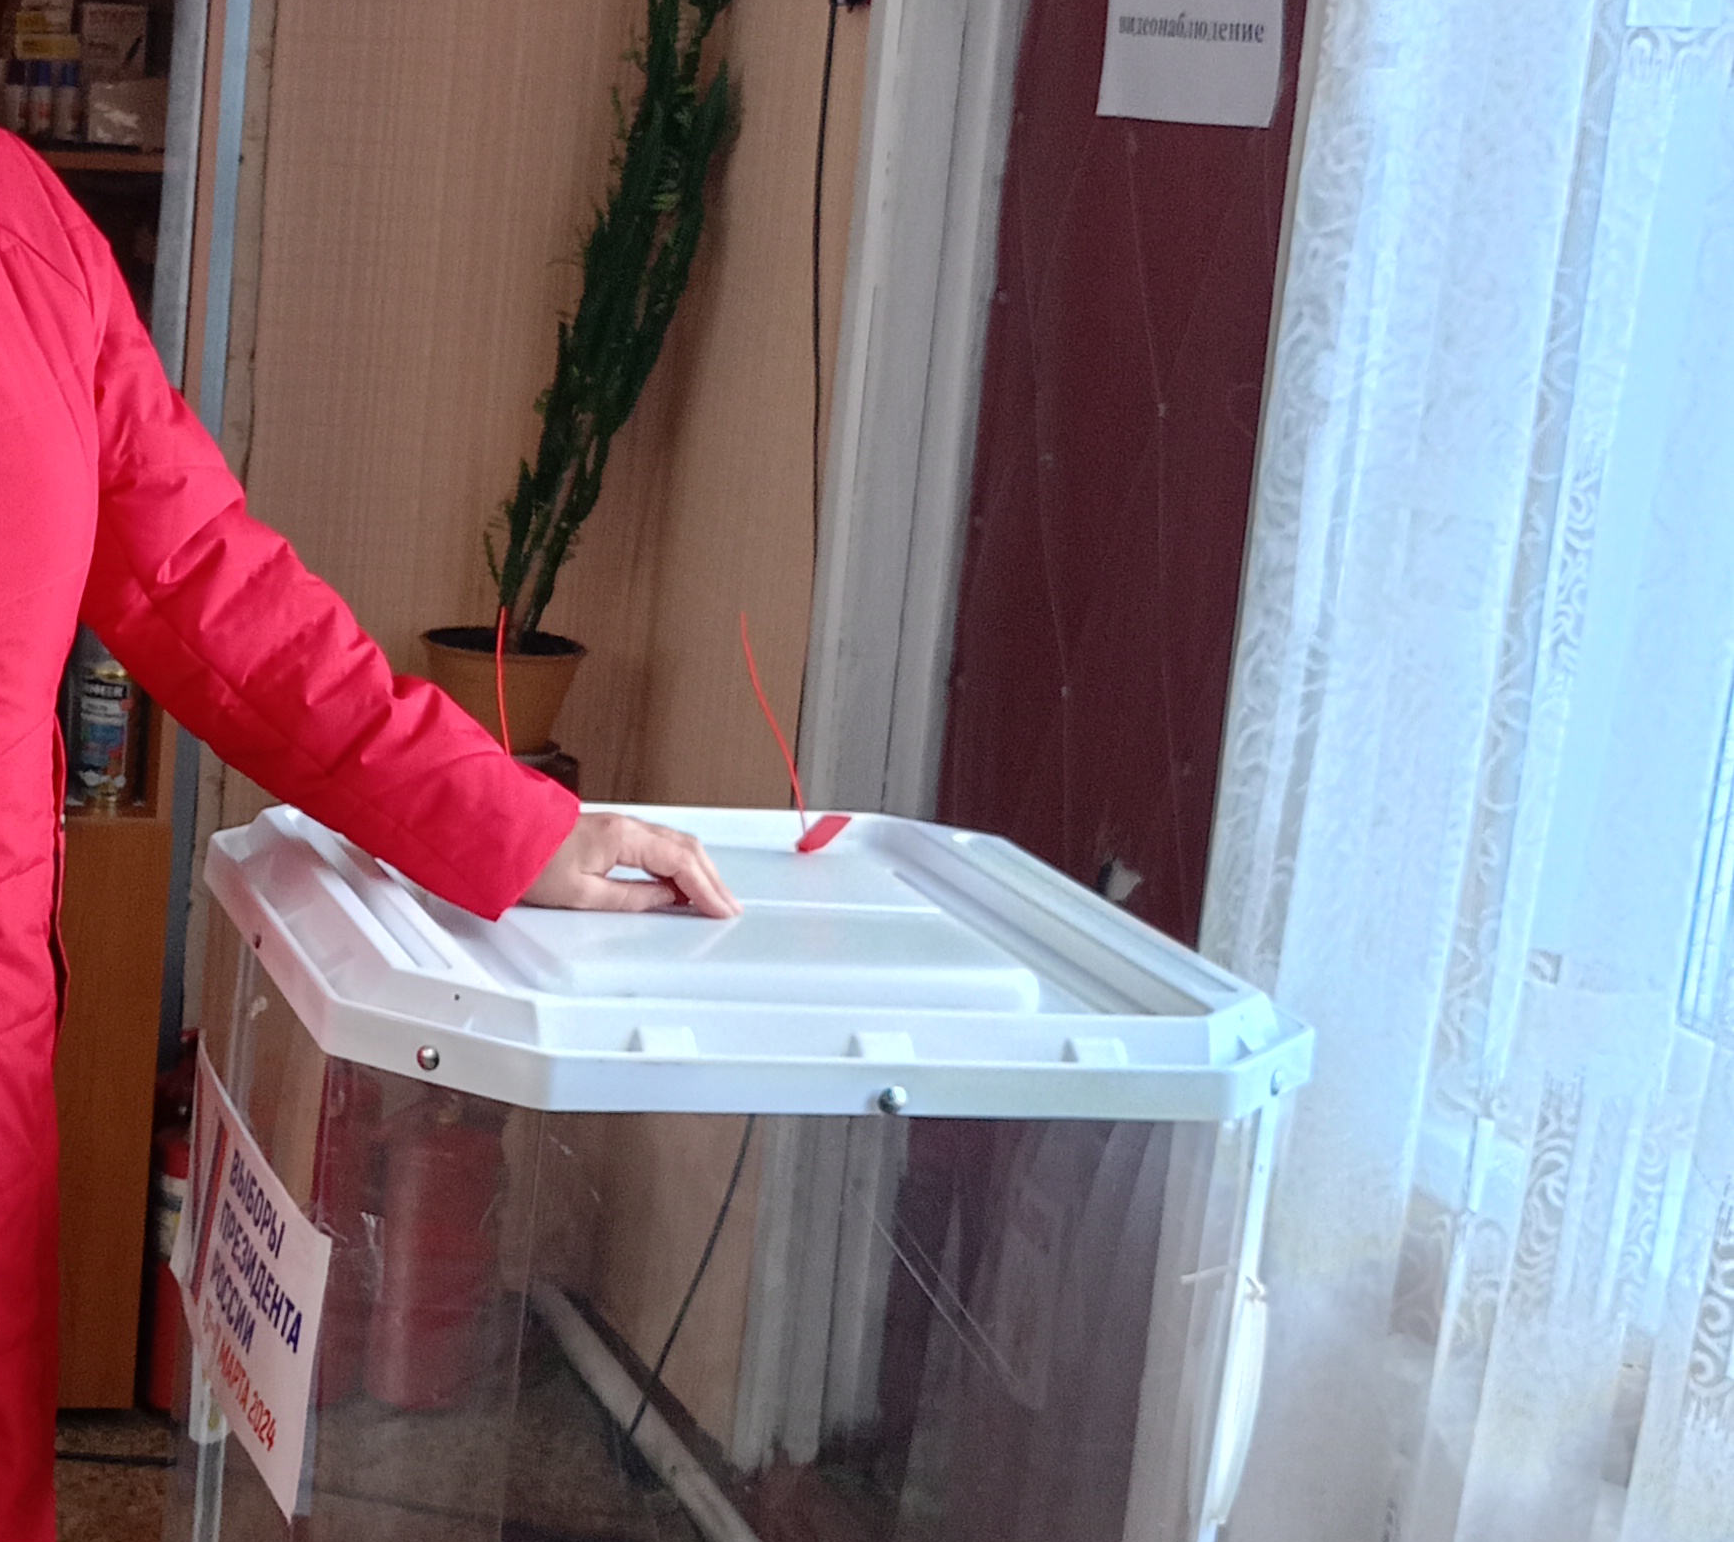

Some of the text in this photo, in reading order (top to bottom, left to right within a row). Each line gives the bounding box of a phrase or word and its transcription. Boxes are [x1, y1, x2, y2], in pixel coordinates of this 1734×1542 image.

[1118, 10, 1265, 44] видеонаблюдение
[229, 1148, 286, 1259] ВЫБОРЫ
[210, 1248, 256, 1355] РОССИИ
[219, 1196, 303, 1354] ПРЕЗИДЕНТА
[246, 1389, 277, 1452] 2024
